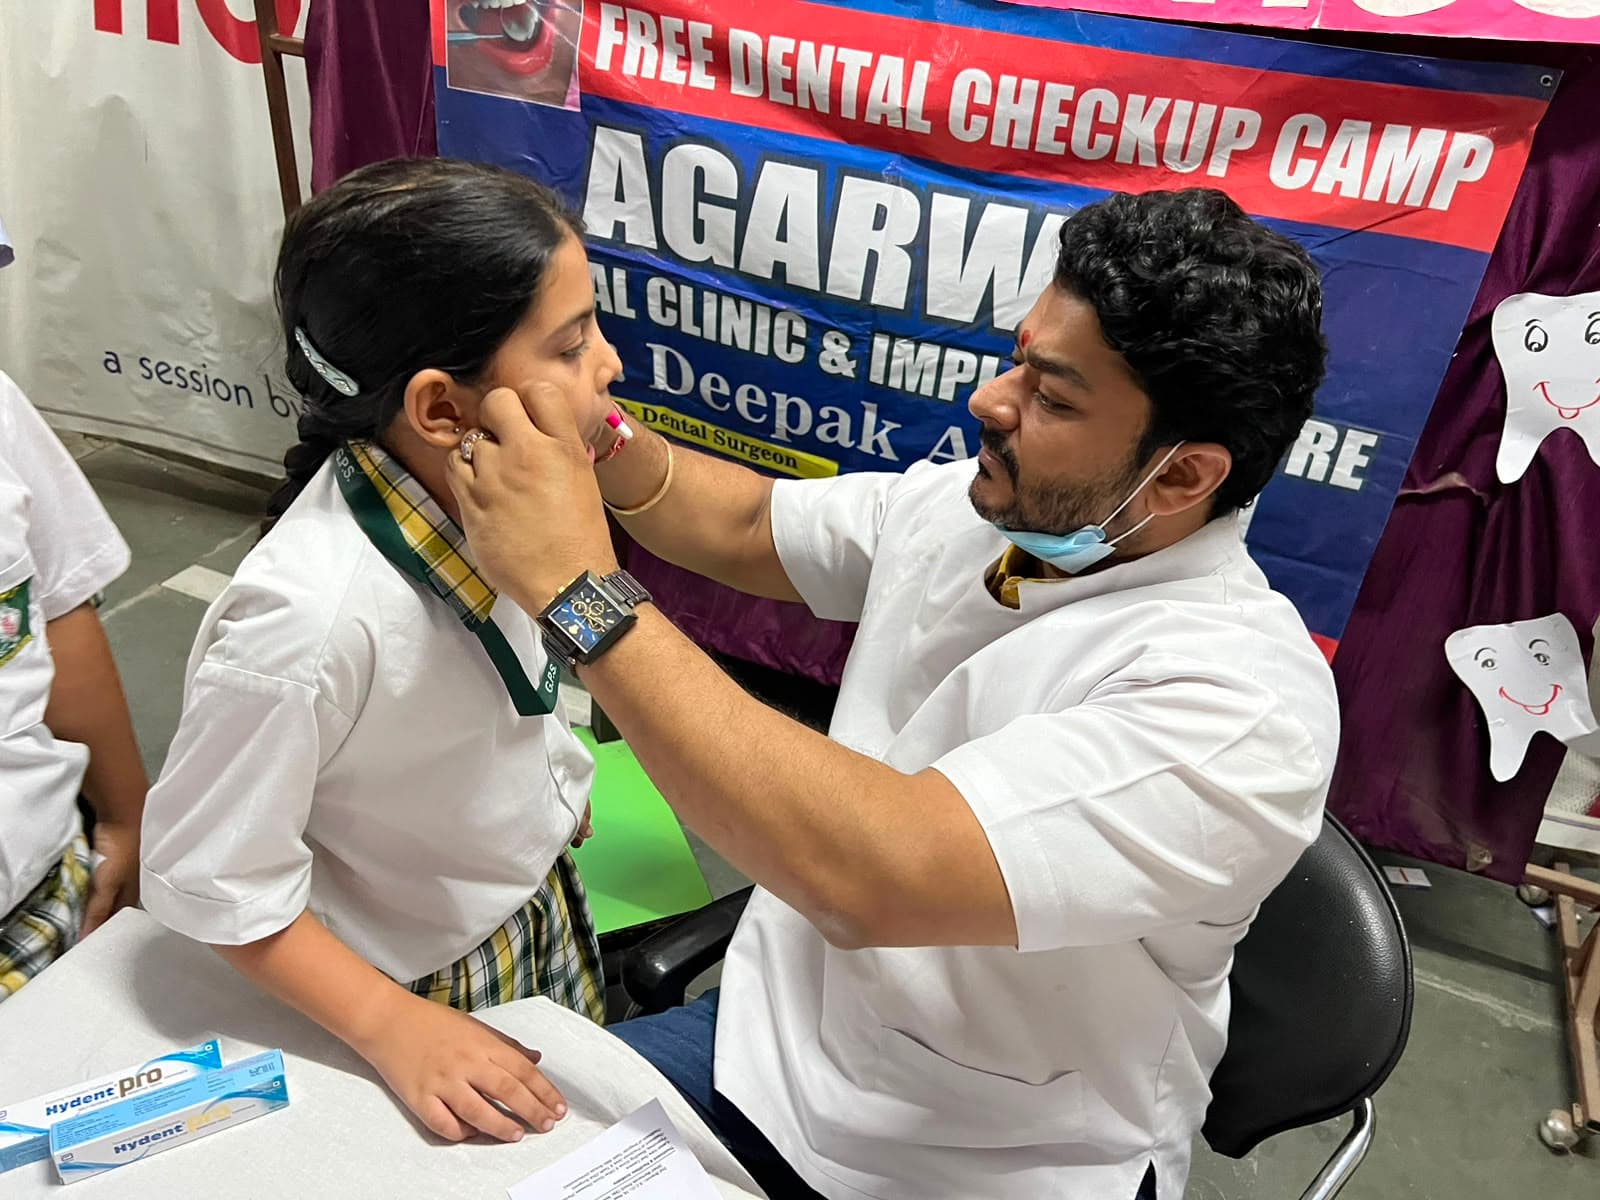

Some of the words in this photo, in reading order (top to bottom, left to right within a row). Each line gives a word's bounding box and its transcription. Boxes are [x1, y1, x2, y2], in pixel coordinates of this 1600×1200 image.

[595, 4, 716, 92] FREE
[727, 29, 932, 133] DENTAL
[948, 67, 1262, 178] CHECKUP
[1269, 113, 1494, 211] CAMP
[583, 125, 1069, 332] AGARW
[646, 276, 807, 363] CLINIC
[818, 330, 857, 378] &
[103, 351, 122, 374] a
[139, 357, 254, 408] session
[645, 343, 902, 461] Deepak
[642, 407, 707, 440] Dental
[713, 429, 798, 469] Surgeon
[1284, 419, 1378, 491] RE
[46, 1087, 115, 1116] Hydent
[118, 1067, 163, 1098] pro
[113, 1124, 184, 1154] Hydent
